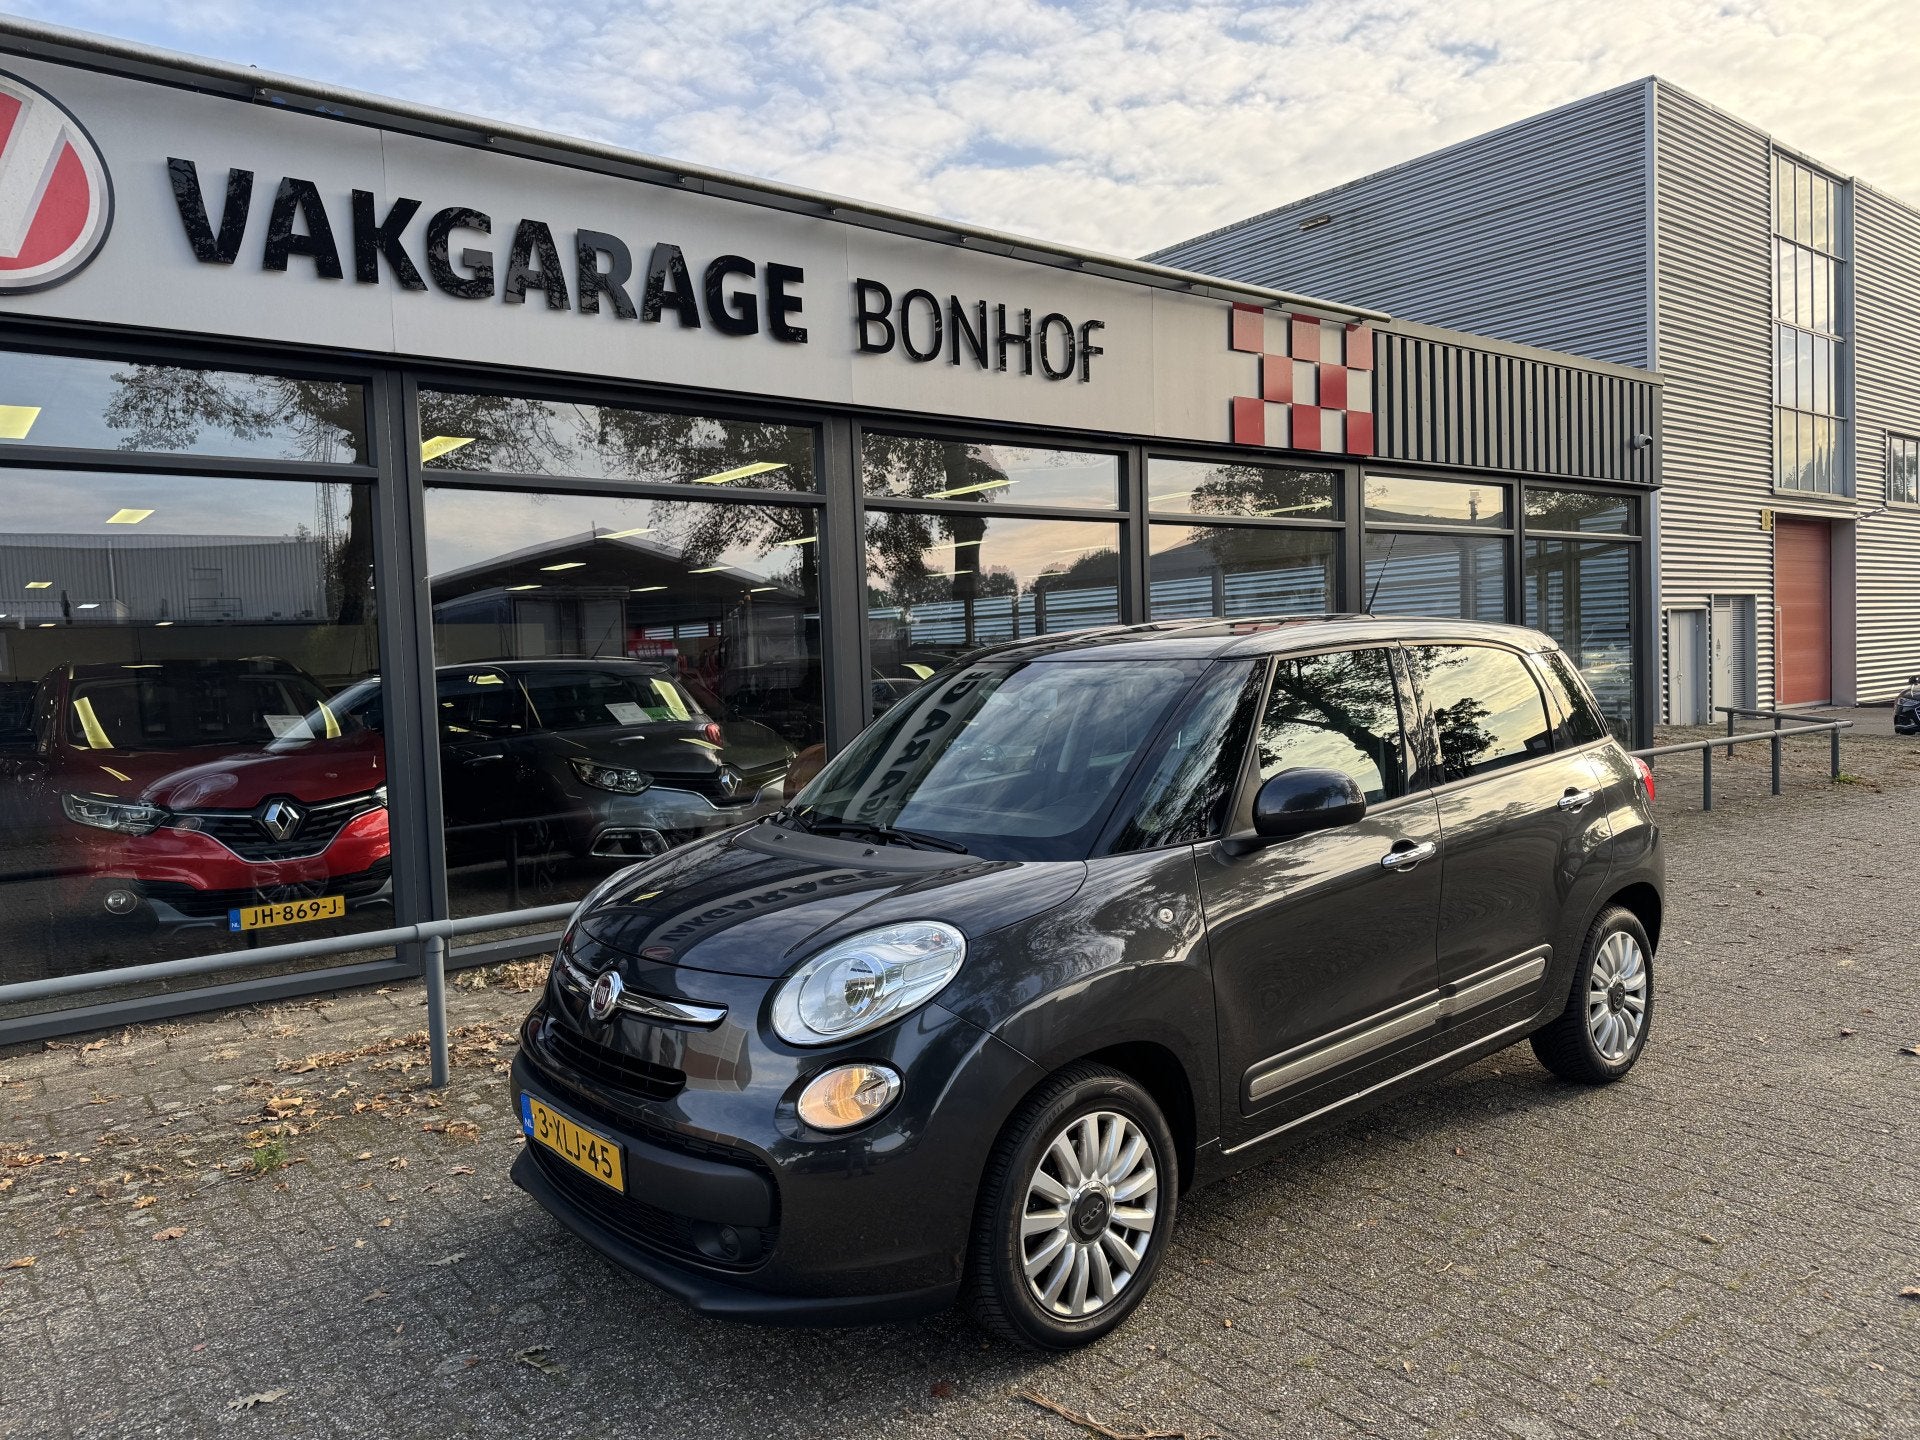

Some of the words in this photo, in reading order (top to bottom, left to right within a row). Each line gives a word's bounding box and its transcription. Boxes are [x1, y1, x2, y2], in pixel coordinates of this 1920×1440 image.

[167, 157, 808, 344] VAKGARAGE
[856, 277, 1105, 383] BONHOF
[249, 899, 337, 926] JH-869-J
[524, 1117, 534, 1129] NL
[538, 1107, 613, 1179] 3-XLJ-45
